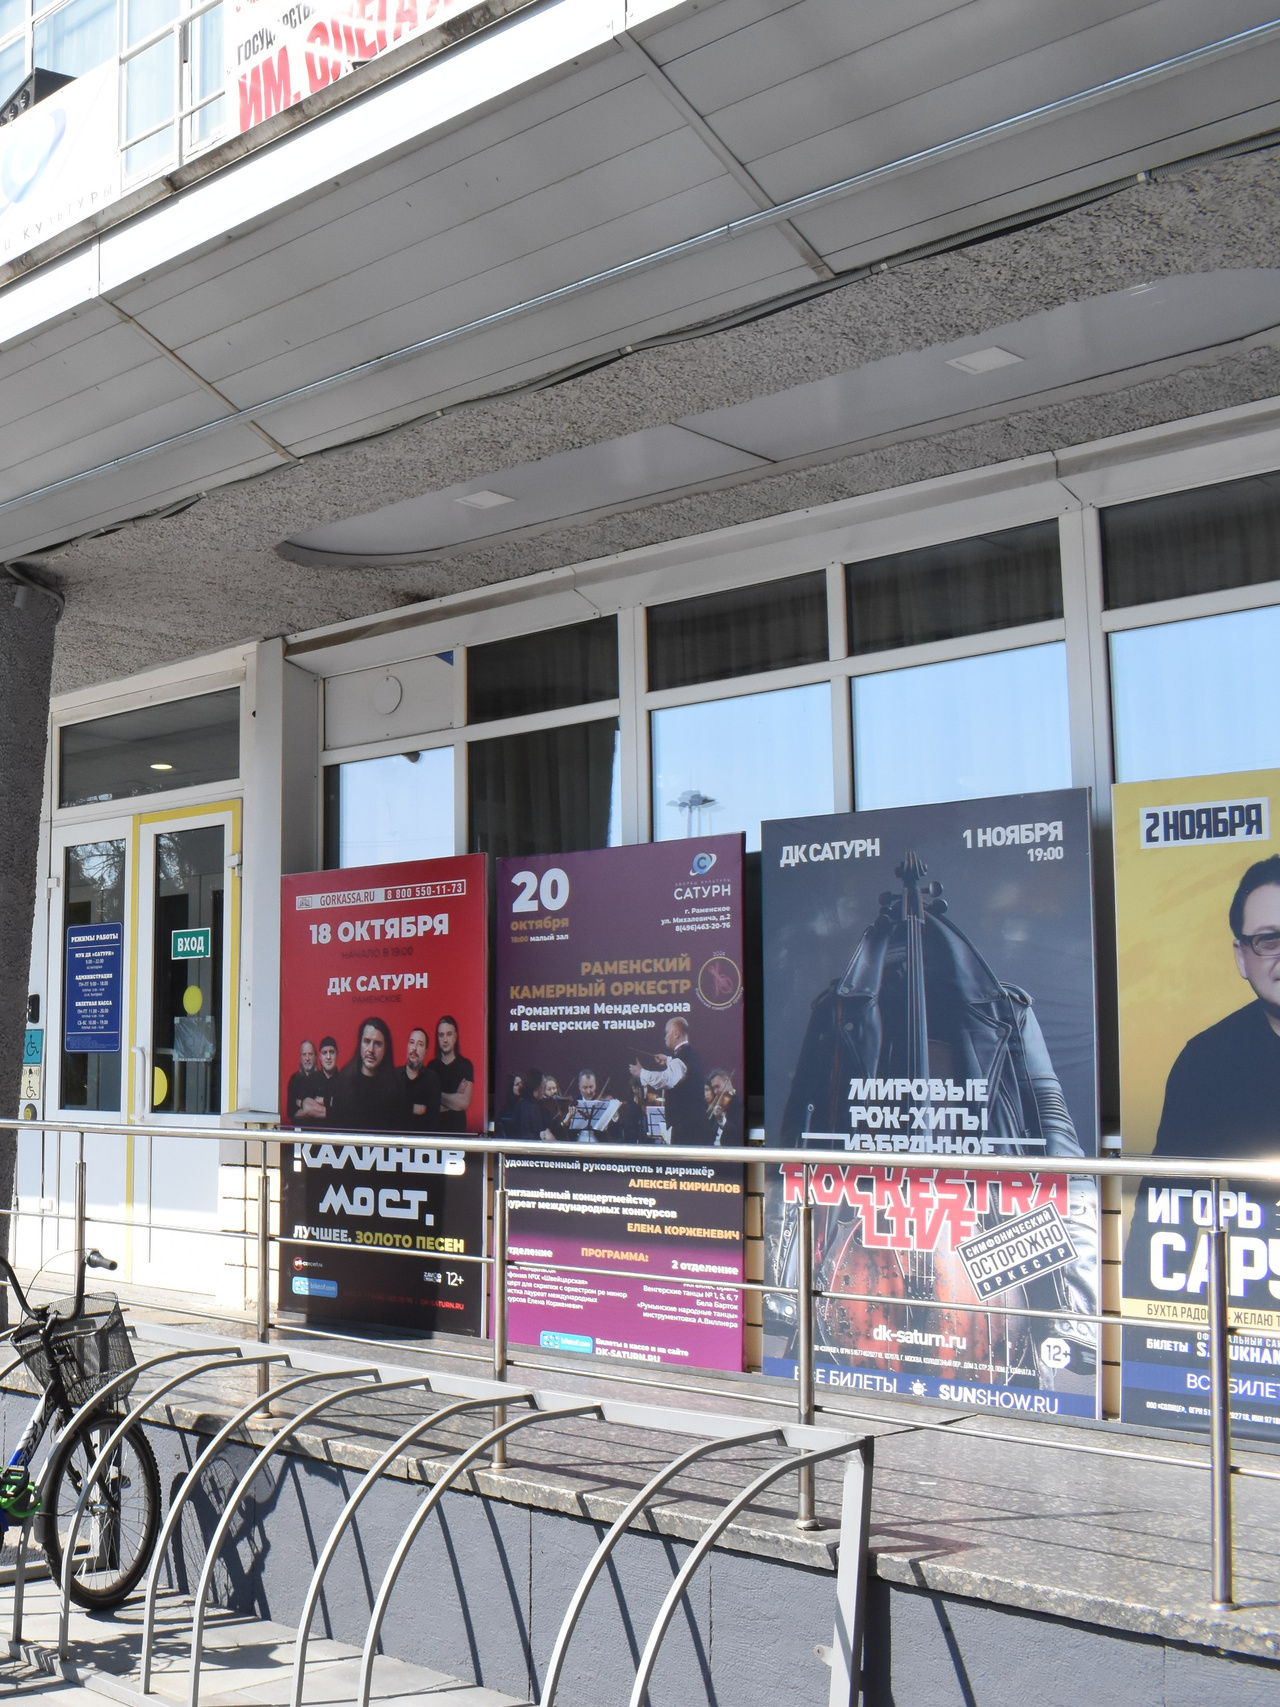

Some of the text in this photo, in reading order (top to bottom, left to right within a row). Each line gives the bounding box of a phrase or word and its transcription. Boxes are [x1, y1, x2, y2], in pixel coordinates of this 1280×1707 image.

[238, 45, 301, 133] ИМ.
[1145, 803, 1263, 843] 2 НОЯБРЯ
[962, 821, 1063, 849] 1 НОЯБРЯ
[780, 838, 880, 867] ДК САТУРН
[1027, 846, 1064, 862] 19:00
[320, 890, 375, 906] GORKASSA.RU
[387, 883, 462, 900] 8 800 550-11-73
[511, 868, 570, 913] 20
[674, 884, 731, 900] САТУРН
[691, 906, 731, 914] Раменское
[511, 916, 570, 932] октября
[672, 915, 718, 924] Михалевича,
[675, 922, 731, 932] 8(496)463-20-76
[309, 913, 449, 945] 18 ОКТЯБРЯ
[177, 936, 204, 953] ВХОД
[530, 933, 554, 943] малый
[581, 953, 691, 976] РАМЕНСКИЙ
[327, 973, 428, 995] ДК САТУРН
[510, 979, 691, 1000] КАМЕРНЫЙ ОРКЕСТР
[510, 1002, 691, 1017] «Романтизм Мендельсона
[510, 1019, 655, 1033] и Венгерские танцы»
[847, 1078, 989, 1101] МИРОВЫЕ
[849, 1105, 989, 1131] РОК-ХИТЫ
[844, 1133, 996, 1155] ИЗБРАННОЕ
[504, 1158, 581, 1170] удожественный
[583, 1162, 653, 1174] руководитель
[665, 1166, 715, 1178] дирижёр
[629, 1178, 740, 1194] АЛЕКСЕЙ КИРИЛЛОВ
[780, 1162, 1070, 1217] ROCKESTRA
[319, 1183, 434, 1226] МОСТ.
[572, 1192, 656, 1207] концертмейстер
[538, 1202, 677, 1219] международных конкурсов
[1147, 1187, 1264, 1230] ИГОРЬ
[627, 1222, 740, 1241] ЕЛЕНА КОРЖЕНЕВИЧ
[858, 1198, 977, 1253] LIVE
[965, 1208, 1052, 1258] СИМФОНИЧЕСКИЙ
[293, 1225, 464, 1253] ЛУЧШЕЕ. ЗОЛОТО ПЕСЕН
[508, 1246, 649, 1263] тделение ПРОГРАММА:
[970, 1224, 1064, 1280] ОСТОРОЖНО
[671, 1259, 739, 1275] 2 отделение
[983, 1248, 1065, 1292] ОРКЕСТР
[446, 1271, 464, 1287] 12+
[548, 1292, 597, 1303] международных
[564, 1286, 597, 1295] оркестром
[607, 1291, 627, 1299] минор
[643, 1285, 682, 1295] Венгерские
[683, 1290, 704, 1298] танцы
[527, 1297, 583, 1310] Елена Корженевич
[637, 1302, 677, 1312] «Румынские
[678, 1307, 712, 1316] народные
[696, 1299, 738, 1310] Бела Барток
[643, 1312, 696, 1323] инструментовка
[1147, 1303, 1273, 1326] БУХТА ЖЕЛАЮ
[873, 1324, 966, 1350] dk-saturn.ru
[1146, 1338, 1189, 1353] БИЛЕТЫ
[596, 1338, 622, 1347] Билеты
[629, 1343, 649, 1351] кассе
[667, 1348, 689, 1357] сайте
[596, 1347, 661, 1362] DK-SATURN.RU
[1046, 1344, 1070, 1362] 12+
[794, 1365, 1059, 1414] ВЕ БИЛЕТЫ SUNSHOW.RU
[1146, 1401, 1156, 1409] ООО
[1188, 1406, 1203, 1415] ОГРН
